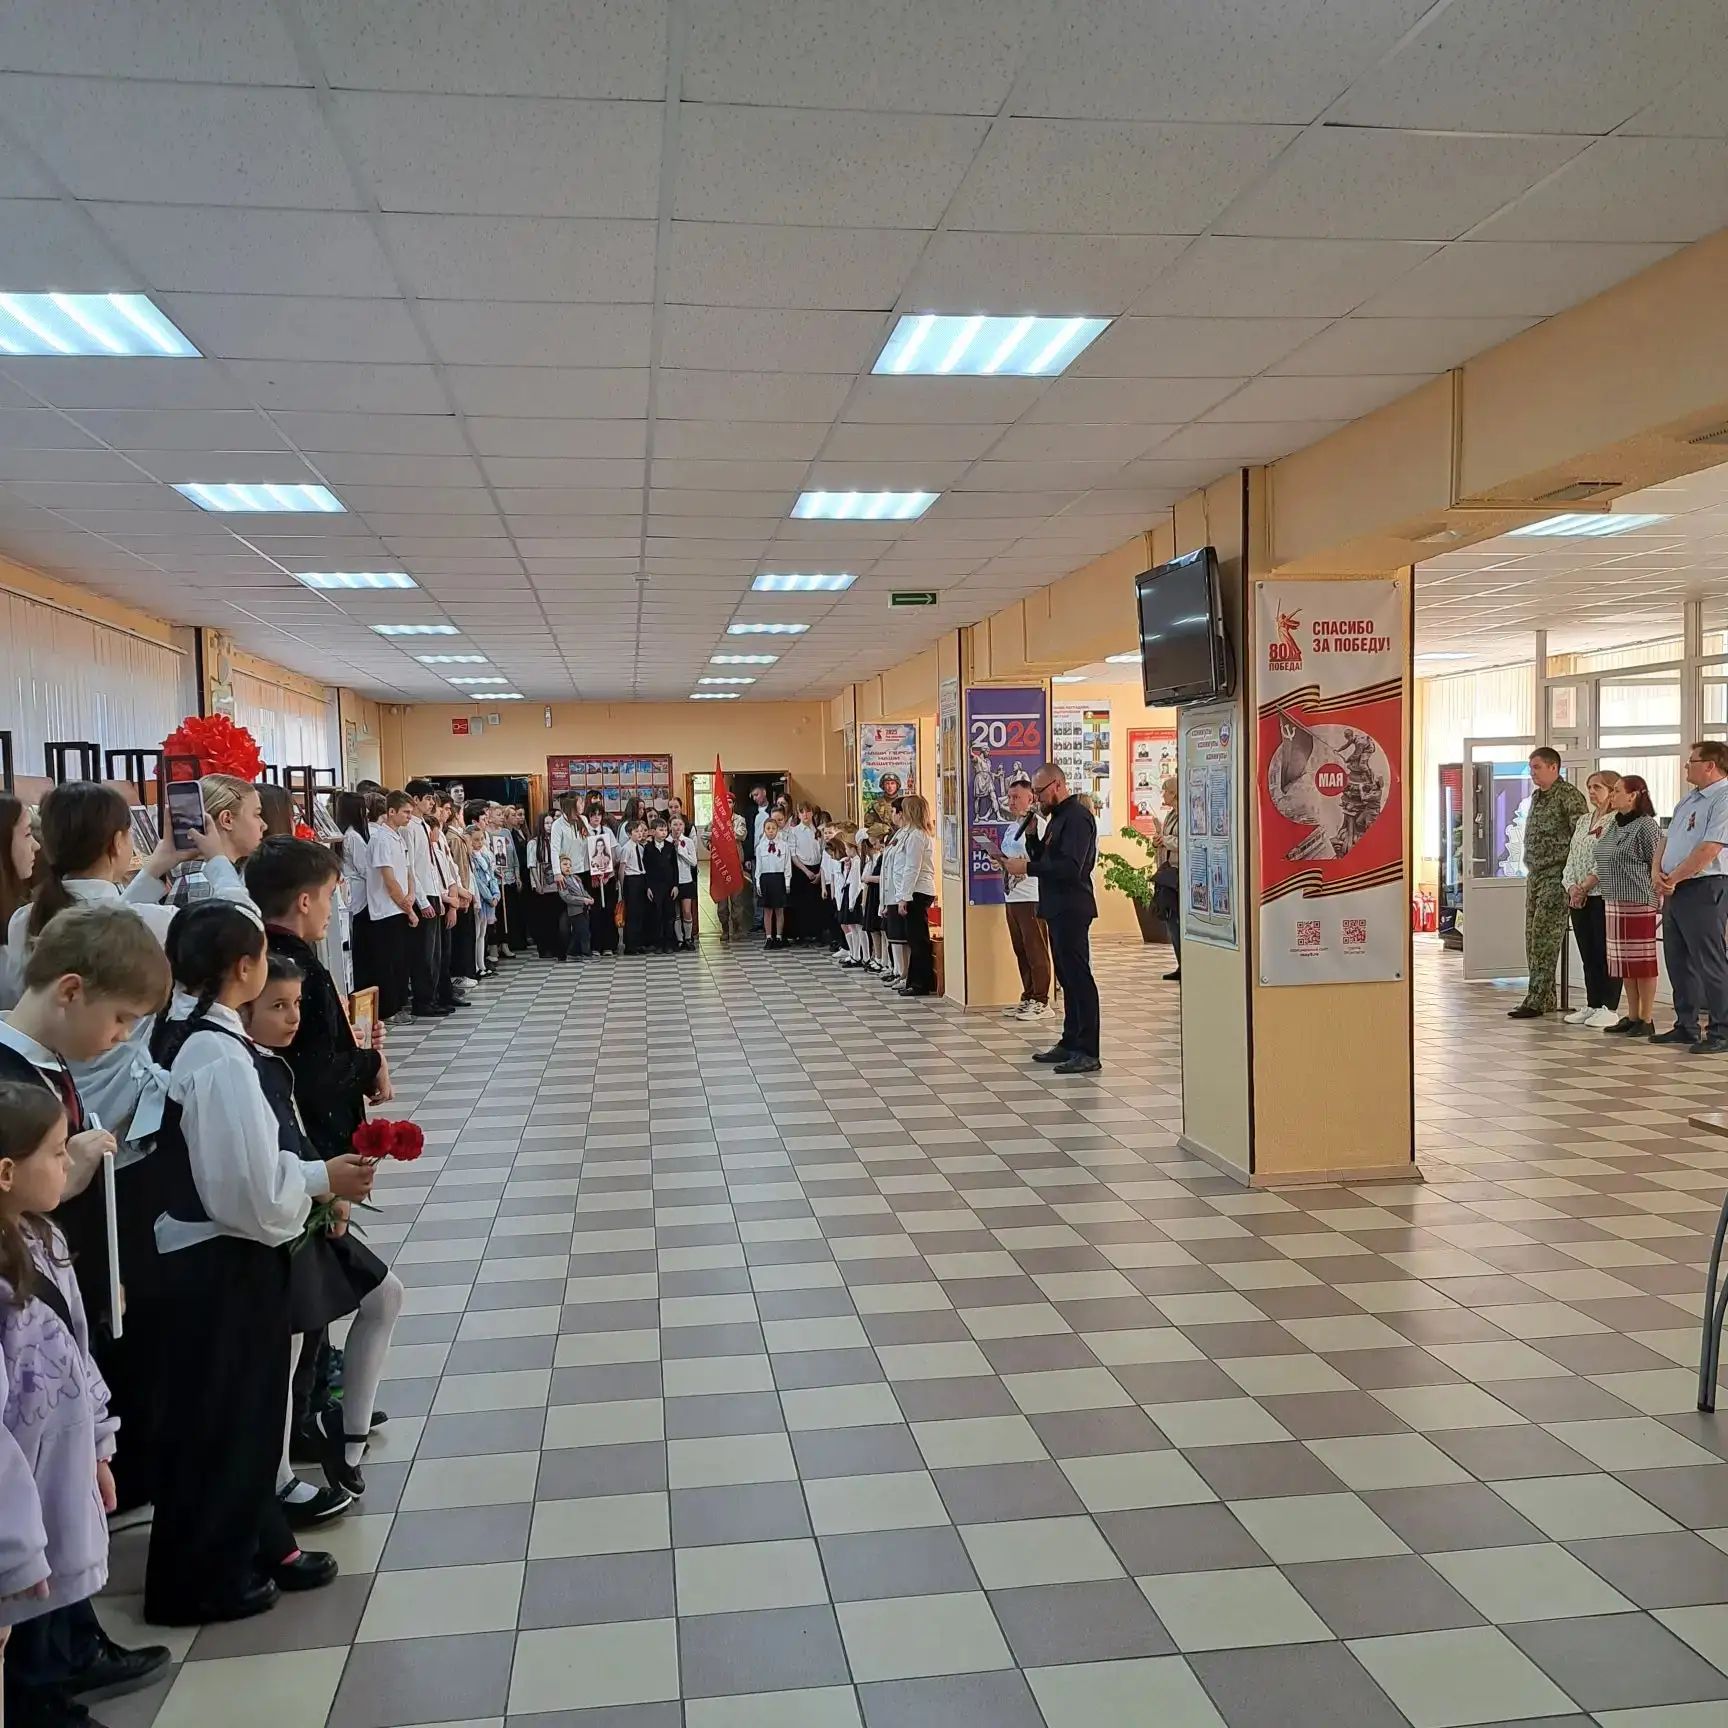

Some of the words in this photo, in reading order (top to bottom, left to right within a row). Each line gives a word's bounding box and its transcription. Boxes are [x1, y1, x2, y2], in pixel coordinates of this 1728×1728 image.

[1312, 620, 1374, 635] СПАСИБО
[1269, 643, 1288, 659] 80
[1312, 638, 1330, 652] ЗА
[1334, 637, 1391, 653] ПОБЕДУ!
[1269, 661, 1302, 671] ПОБЕДА!
[971, 721, 1040, 747] 2026
[1318, 772, 1343, 787] МАЯ
